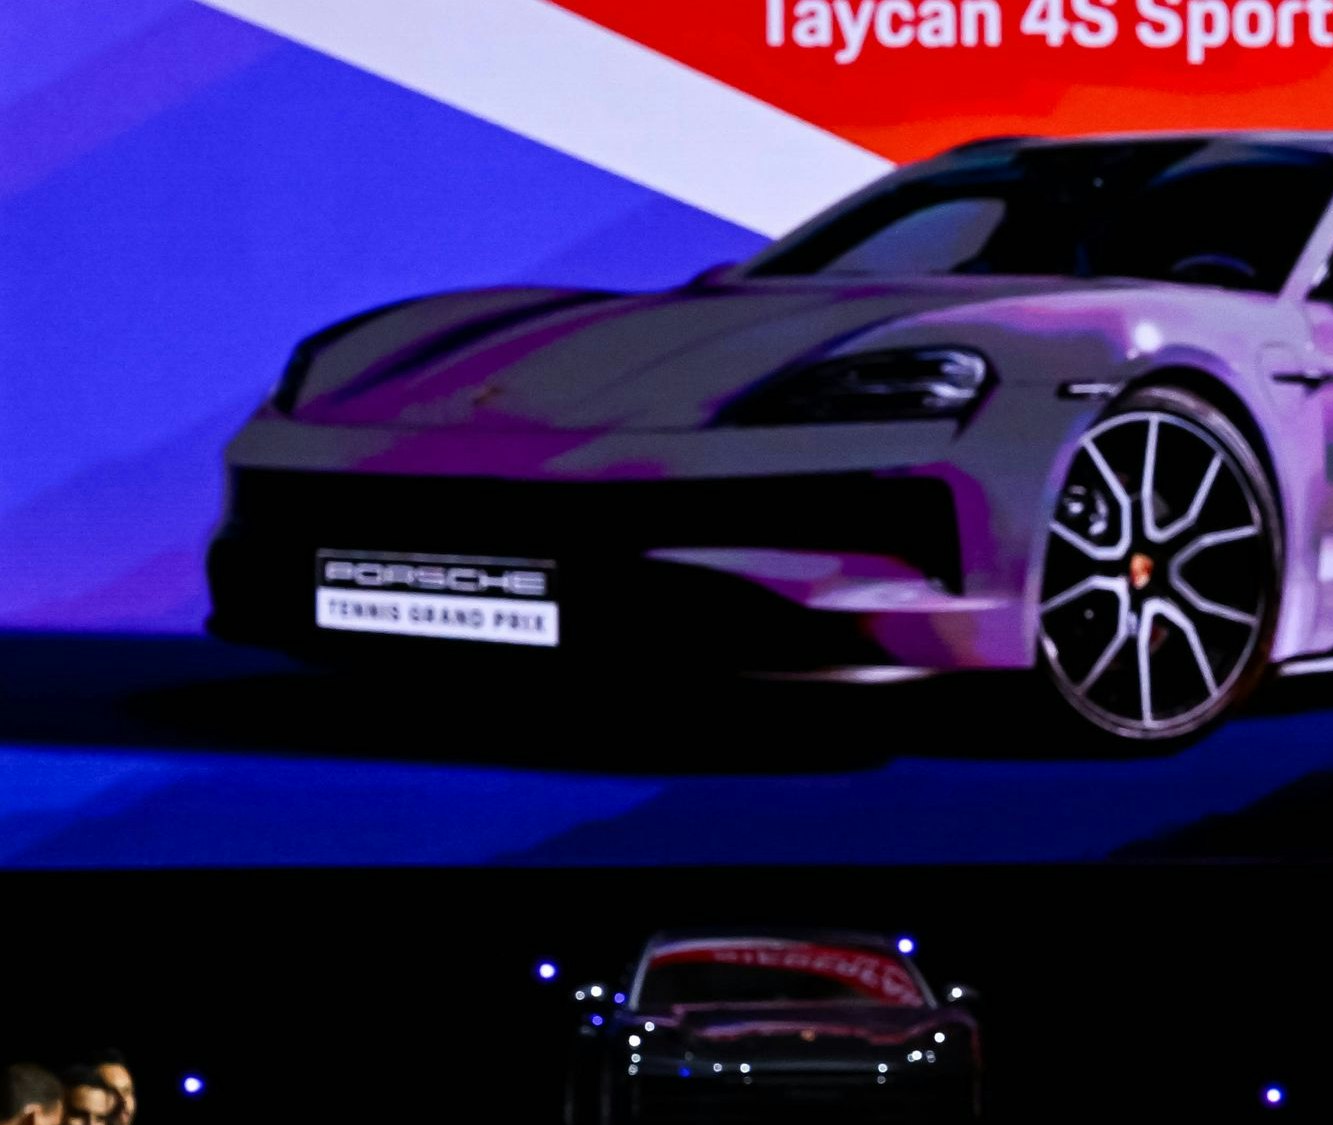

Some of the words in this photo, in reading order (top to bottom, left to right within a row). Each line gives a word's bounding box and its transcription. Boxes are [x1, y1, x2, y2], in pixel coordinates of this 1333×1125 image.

[766, 0, 1001, 64] Taycan
[1020, 0, 1118, 48] 4S
[325, 561, 546, 596] PORSCHE
